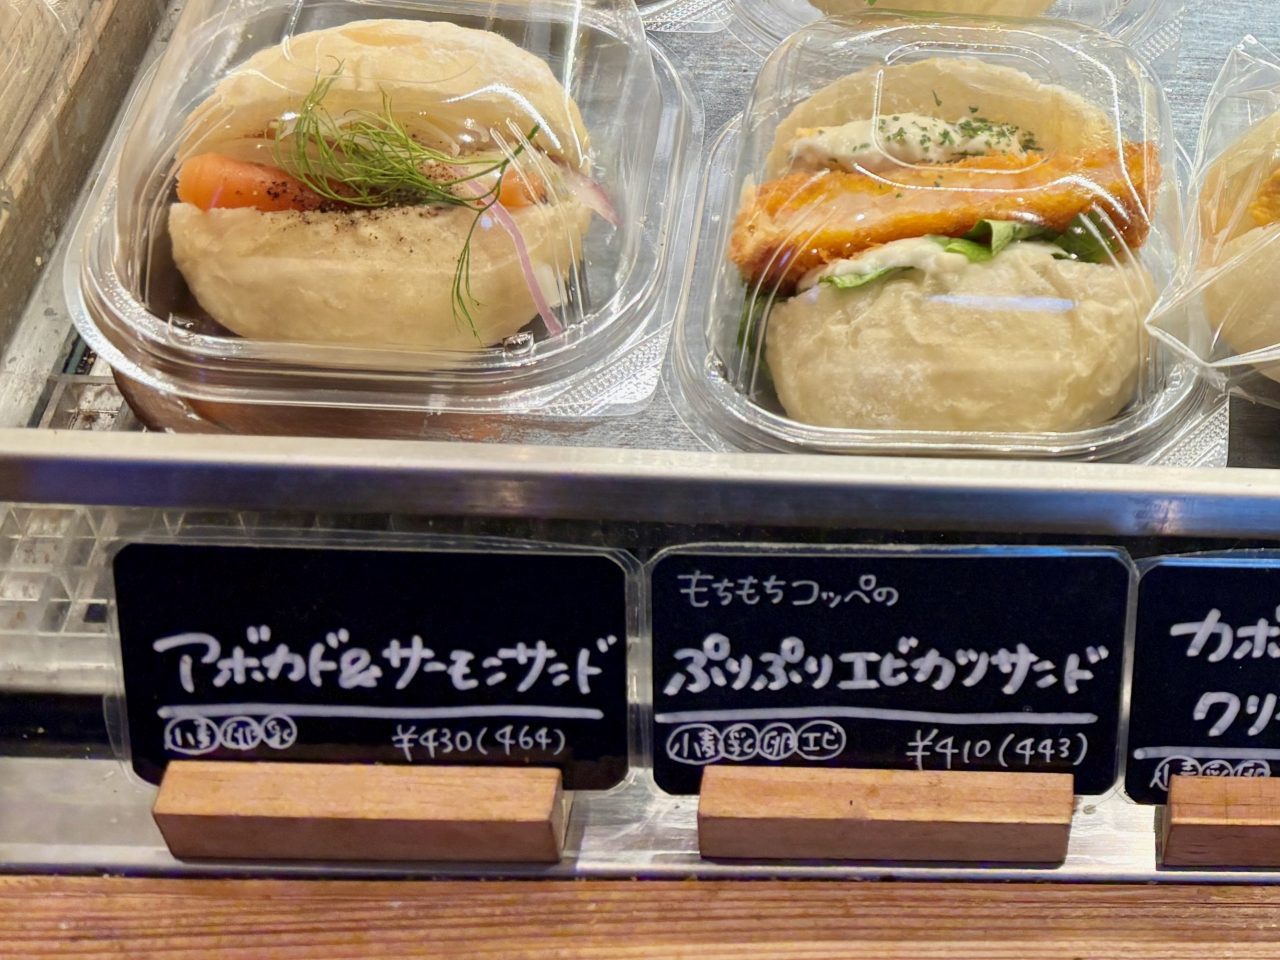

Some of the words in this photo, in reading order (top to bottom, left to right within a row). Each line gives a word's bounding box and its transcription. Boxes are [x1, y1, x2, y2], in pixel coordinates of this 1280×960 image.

[677, 570, 899, 608] もちもちコッペの
[663, 633, 1109, 696] ぷりぷりエビカツサンド
[392, 723, 566, 761] ¥430(464)
[905, 728, 1089, 771] ¥410(443)
